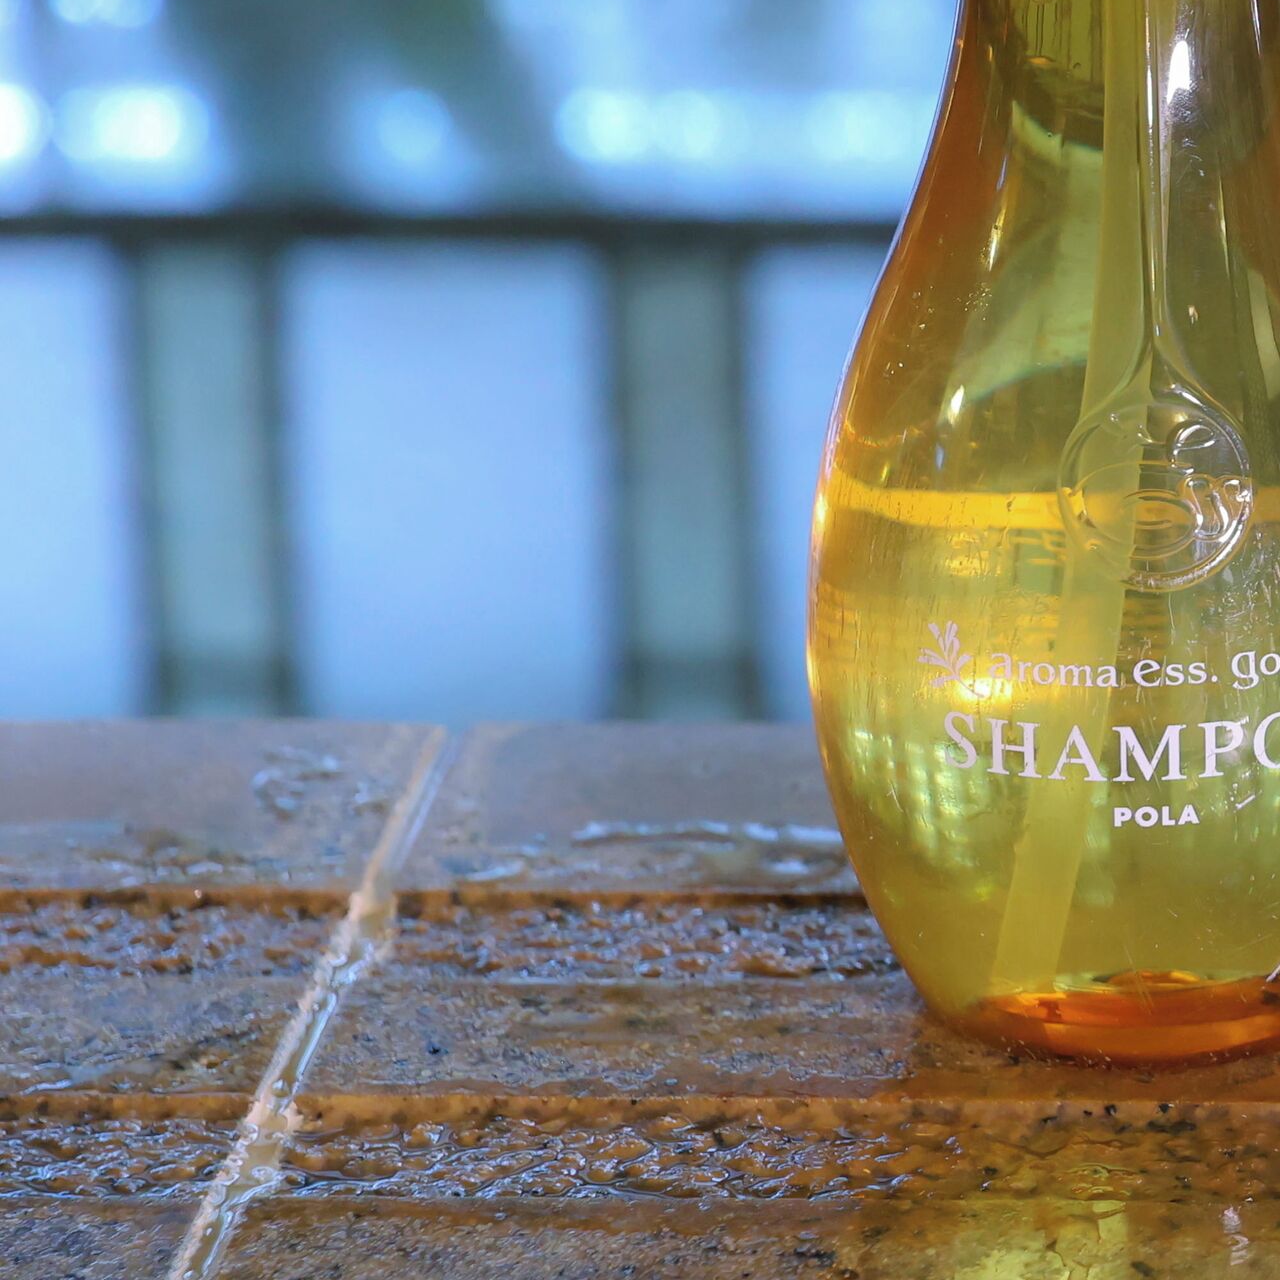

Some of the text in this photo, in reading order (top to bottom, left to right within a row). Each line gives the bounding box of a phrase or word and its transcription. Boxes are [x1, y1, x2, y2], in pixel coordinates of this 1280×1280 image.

[988, 652, 1119, 688] aroma
[1133, 658, 1219, 688] ess.
[1113, 803, 1200, 827] POLA
